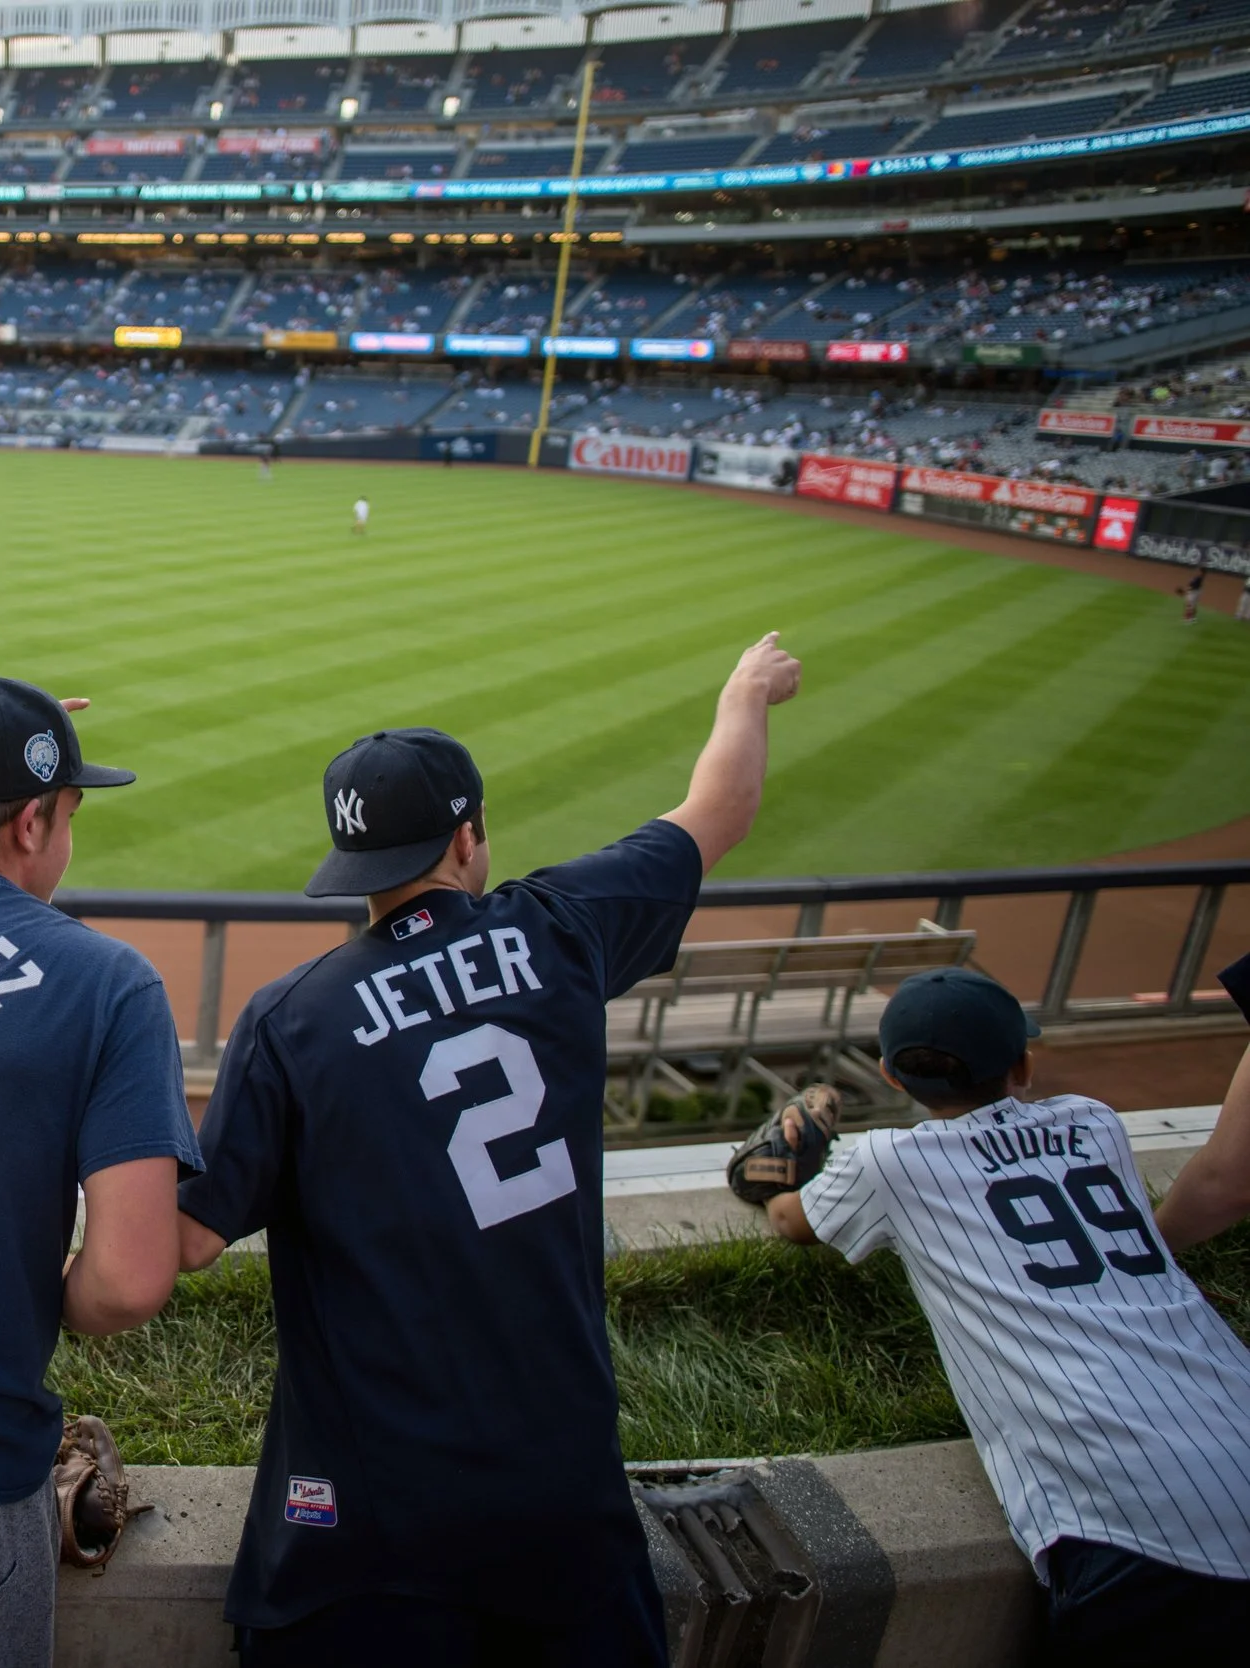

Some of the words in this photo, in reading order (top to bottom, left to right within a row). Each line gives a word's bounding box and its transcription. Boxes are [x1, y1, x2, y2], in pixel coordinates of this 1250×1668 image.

[573, 436, 688, 474] Canon
[1136, 534, 1201, 565] StubHub
[352, 926, 543, 1047] JETER
[418, 1022, 577, 1231] 2
[969, 1124, 1091, 1174] JUDGE
[985, 1164, 1167, 1290] 99
